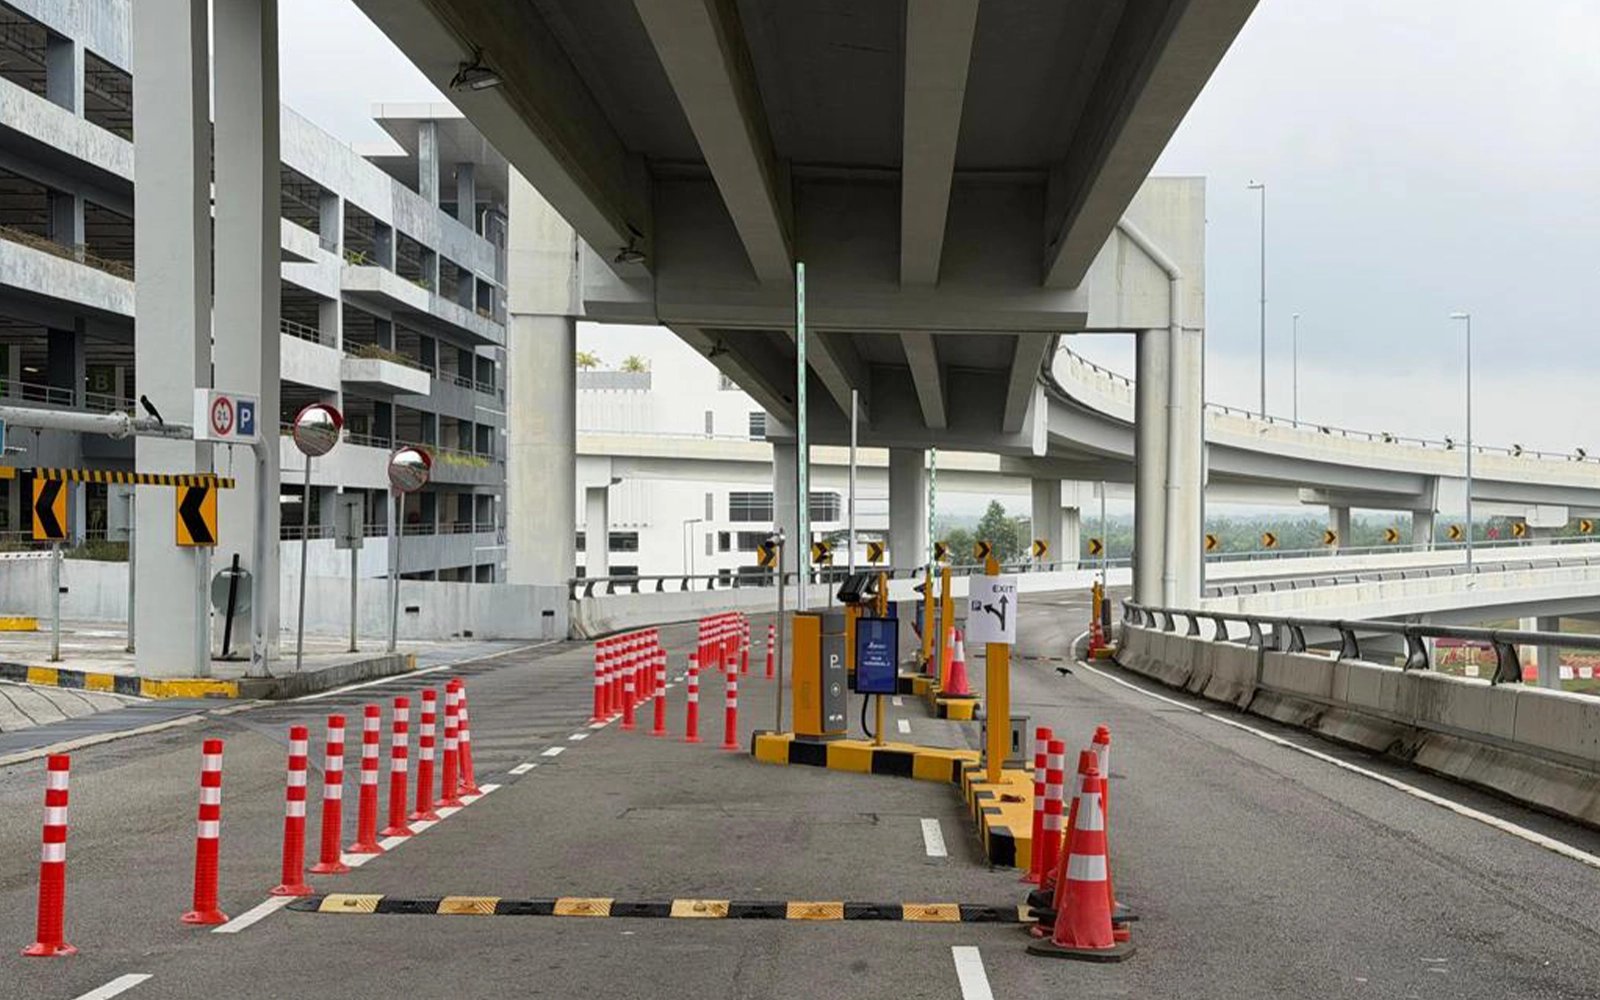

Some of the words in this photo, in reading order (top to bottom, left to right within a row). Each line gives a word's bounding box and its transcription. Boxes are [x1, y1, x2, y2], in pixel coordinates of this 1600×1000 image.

[241, 408, 251, 428] P
[992, 584, 1014, 593] EXIT
[830, 654, 839, 668] P
